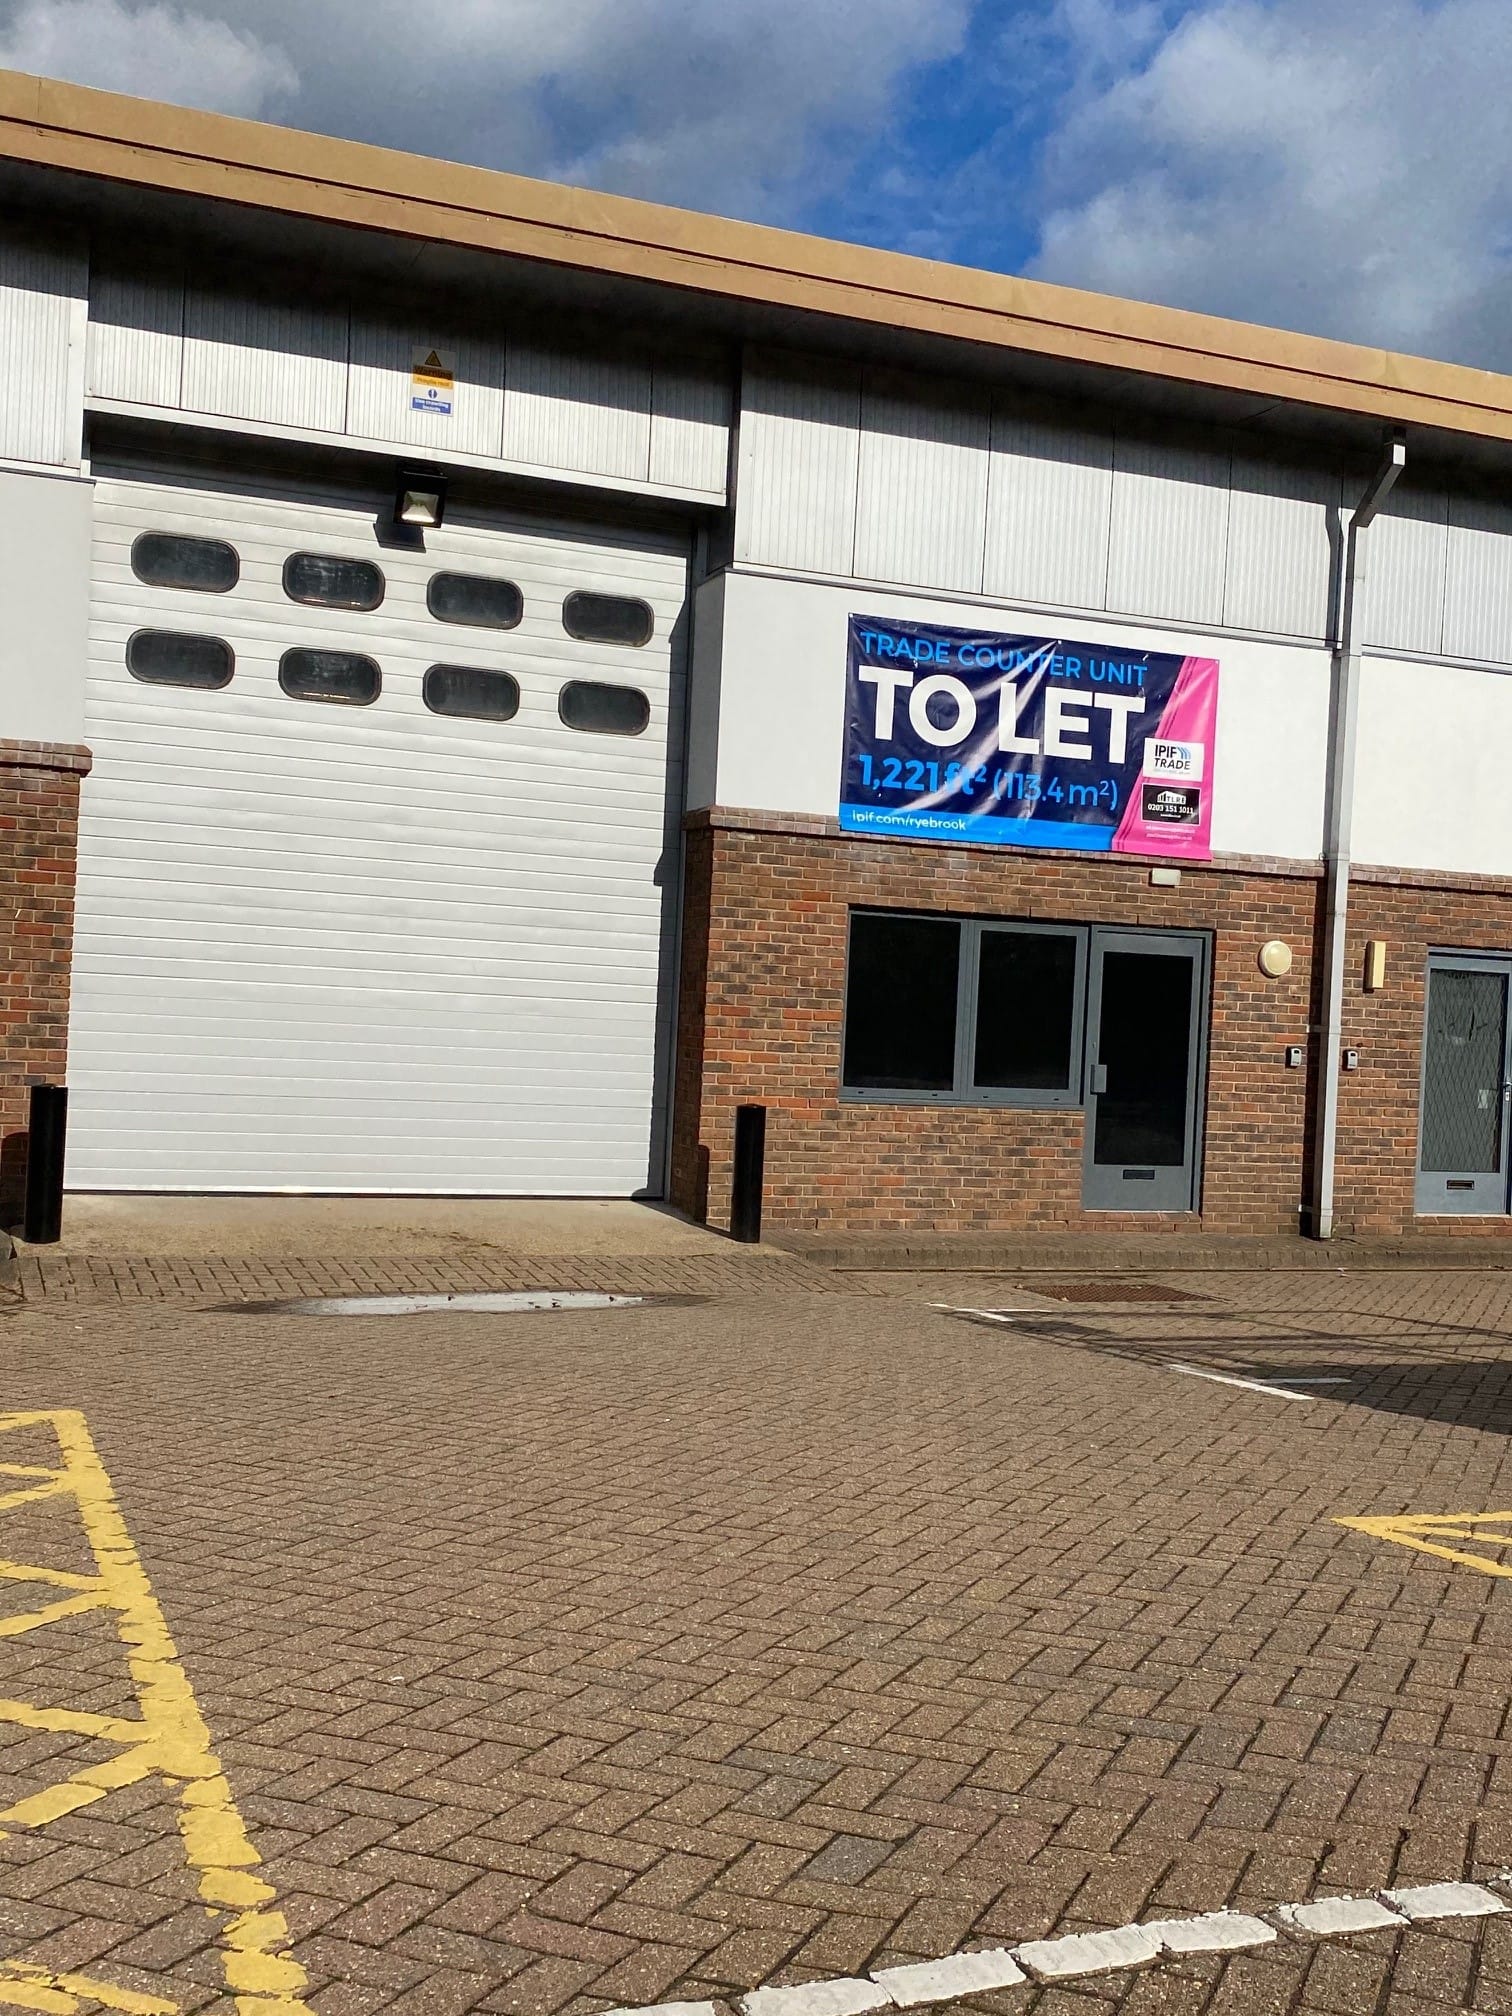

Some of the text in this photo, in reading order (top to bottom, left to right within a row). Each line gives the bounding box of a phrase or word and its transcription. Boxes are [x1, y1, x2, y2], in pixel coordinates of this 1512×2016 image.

[859, 631, 1148, 687] TRADE COUNTER UNIT
[858, 664, 1146, 764] TO LET
[1154, 744, 1177, 758] IPIF
[1154, 757, 1191, 770] TRADE
[1165, 805, 1178, 813] 151
[852, 810, 967, 832] ipif.com/ryebrook
